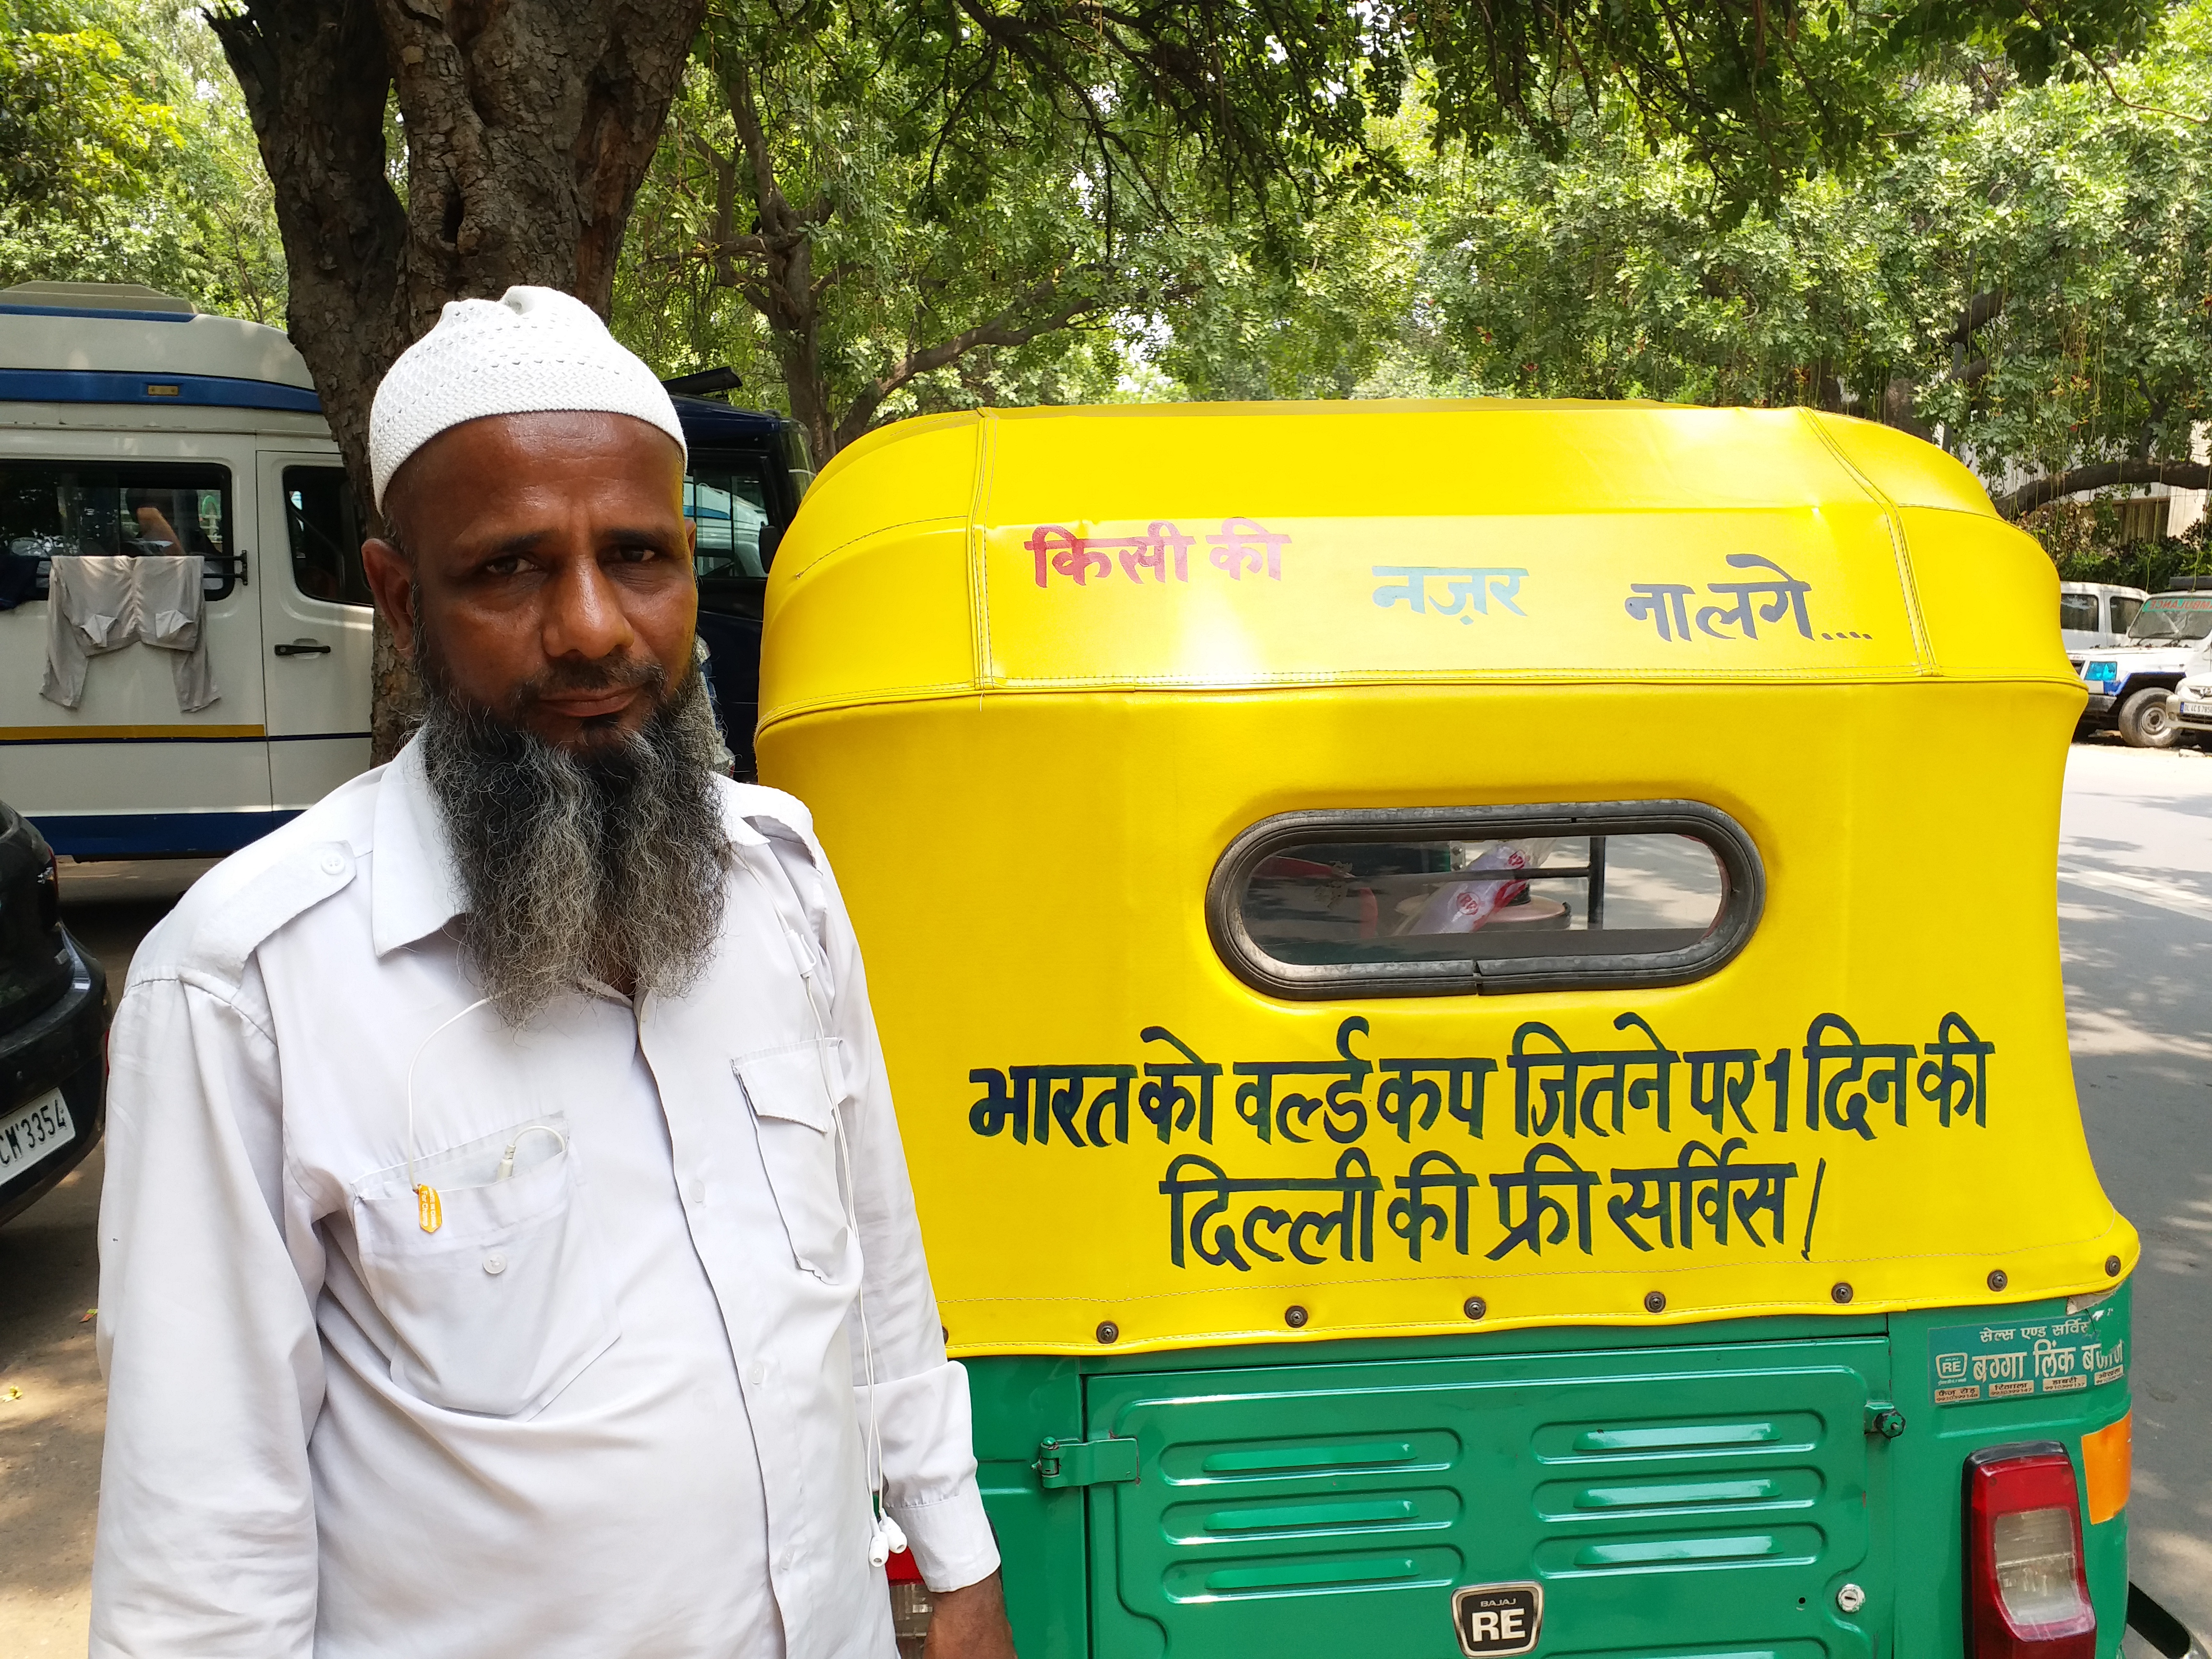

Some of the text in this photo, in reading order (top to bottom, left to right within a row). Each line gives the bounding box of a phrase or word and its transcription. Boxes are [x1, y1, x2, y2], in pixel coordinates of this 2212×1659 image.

[1024, 520, 1196, 588] किसी
[1206, 517, 1292, 581] की
[1372, 566, 1529, 625] नज़र
[1625, 583, 1695, 642] ना
[969, 1011, 1996, 1147] भारत को वर्ल्ड कप जितने पर 1 दिन की
[1159, 1147, 1385, 1272] दिल्ली
[1387, 1150, 1480, 1262] की
[1484, 1142, 1603, 1261] फ्री
[1979, 1327, 2016, 1343] सेल्स
[2020, 1325, 2048, 1340] एण्ड
[1942, 1360, 1961, 1373] RE
[1972, 1351, 2027, 1383] बग्गा
[2033, 1338, 2076, 1378] लिंक
[1480, 1598, 1516, 1608] BAJAJ
[1472, 1608, 1526, 1642] RE
